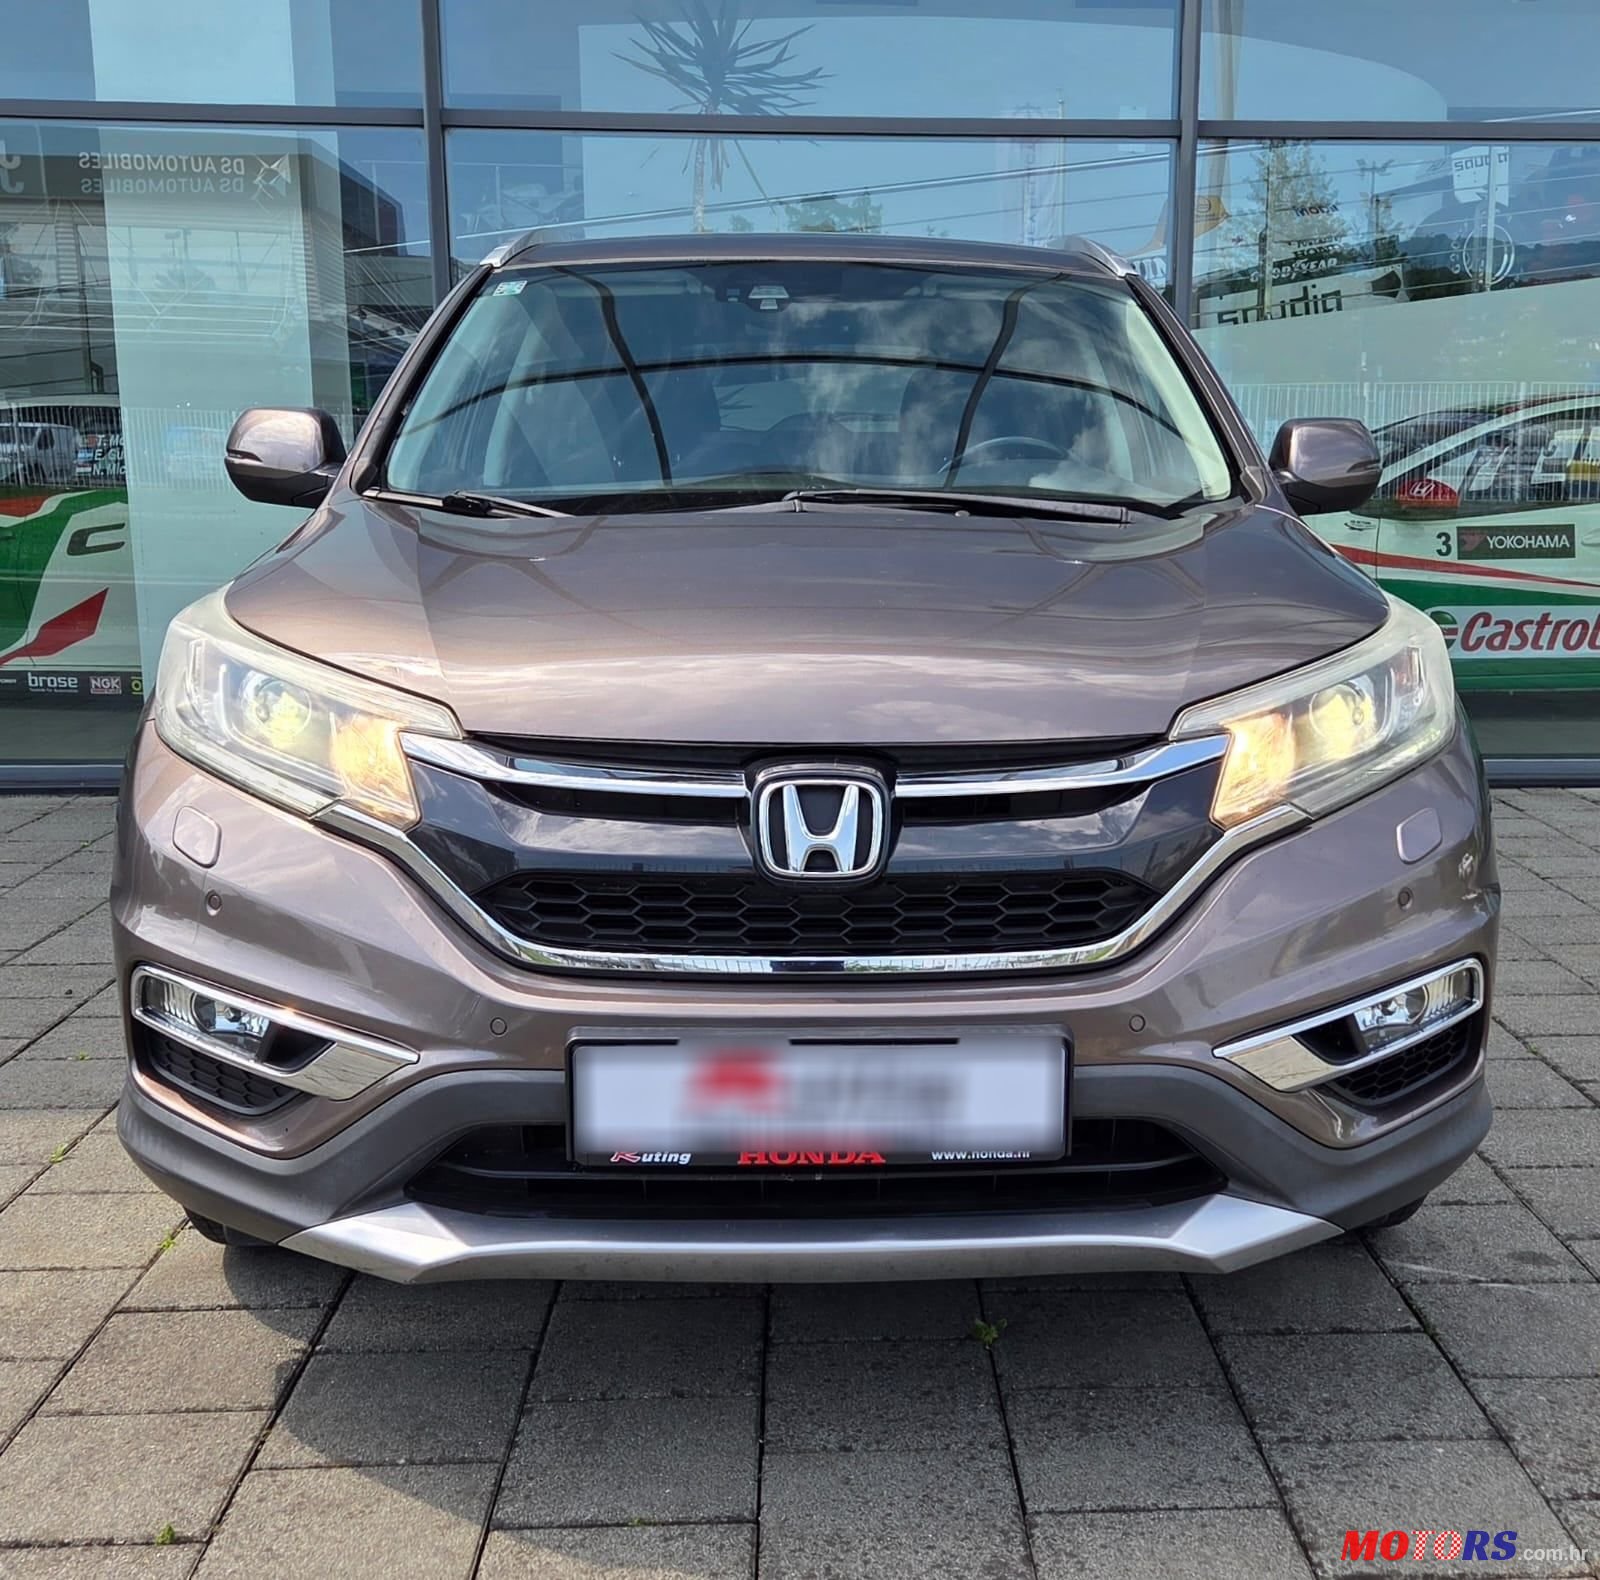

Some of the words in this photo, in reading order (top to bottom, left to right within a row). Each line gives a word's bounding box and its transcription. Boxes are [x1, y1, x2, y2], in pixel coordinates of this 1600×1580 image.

[1436, 532, 1452, 556] 3
[1487, 534, 1570, 549] YOKOHAMA
[1460, 612, 1600, 651] Castrol
[28, 672, 78, 688] brose
[91, 678, 120, 688] NGK
